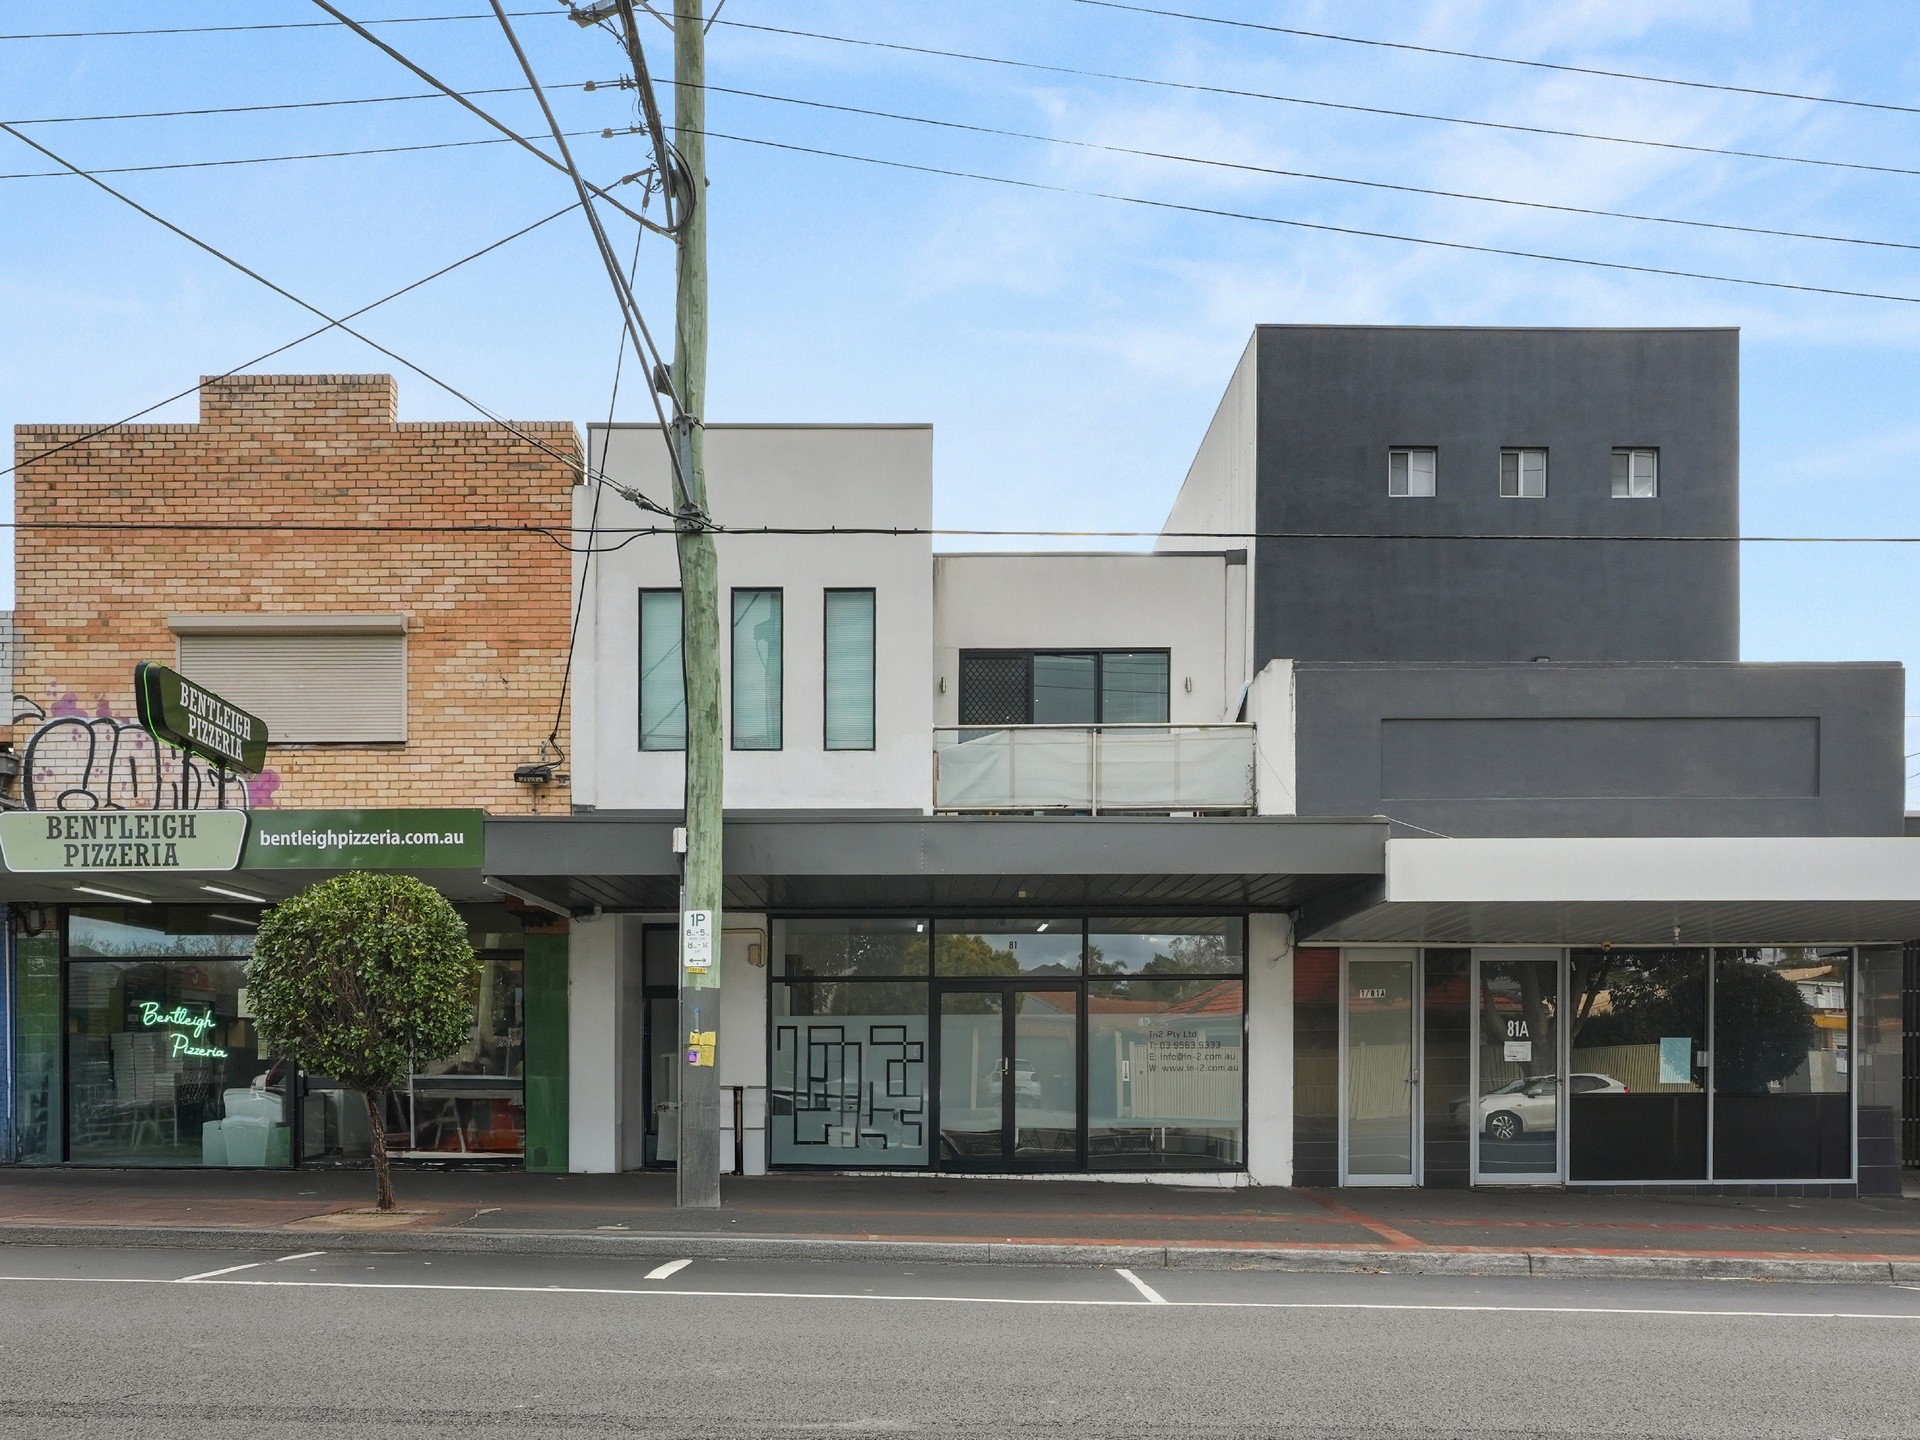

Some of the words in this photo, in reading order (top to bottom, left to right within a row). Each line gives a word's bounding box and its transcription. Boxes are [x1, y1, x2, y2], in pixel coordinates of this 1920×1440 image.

[180, 681, 251, 741] BENTLEIGH
[188, 713, 244, 762] PIZZERIA
[46, 814, 197, 840] BENTLEIGH
[260, 829, 464, 849] bentleighpizzeria.com.au
[63, 842, 179, 867] PIZZERIA
[690, 914, 706, 926] 1P
[1009, 940, 1017, 949] 81
[1361, 989, 1385, 998] 1/81A
[140, 1001, 216, 1038] Bentleigh
[1149, 1030, 1164, 1038] In2
[1167, 1030, 1180, 1039] Pty
[1183, 1030, 1197, 1038] Ltd
[1507, 1020, 1529, 1037] 81A
[170, 1033, 228, 1057] Pizzeria
[1160, 1041, 1171, 1049] 03
[1160, 1052, 1236, 1061] info@in-2.com.au
[1162, 1064, 1239, 1072] www.in-2.com.au
